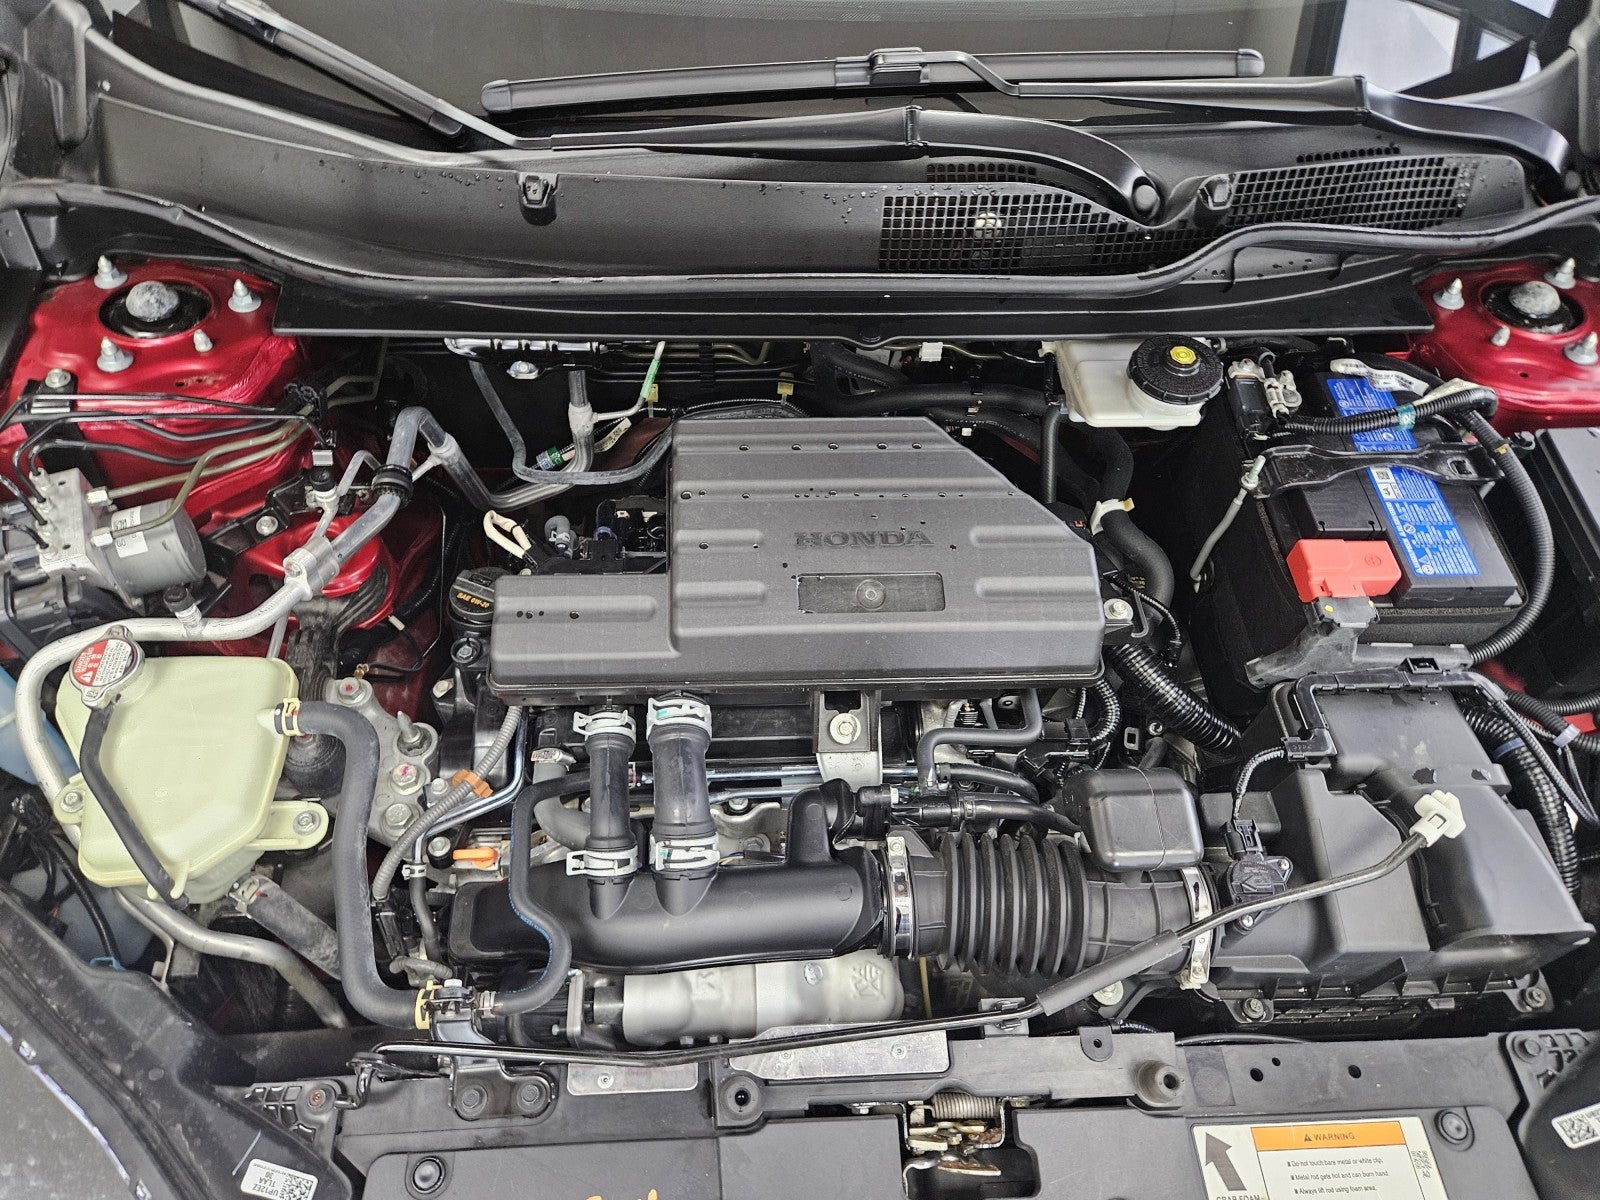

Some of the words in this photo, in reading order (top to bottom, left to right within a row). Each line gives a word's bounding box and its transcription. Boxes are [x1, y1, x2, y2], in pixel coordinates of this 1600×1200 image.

[793, 530, 934, 548] HONDA
[456, 592, 472, 602] SAE
[470, 597, 490, 608] 0W-20
[1313, 1132, 1355, 1141] WARNING
[1320, 1173, 1331, 1181] gets
[1299, 1187, 1317, 1195] Always
